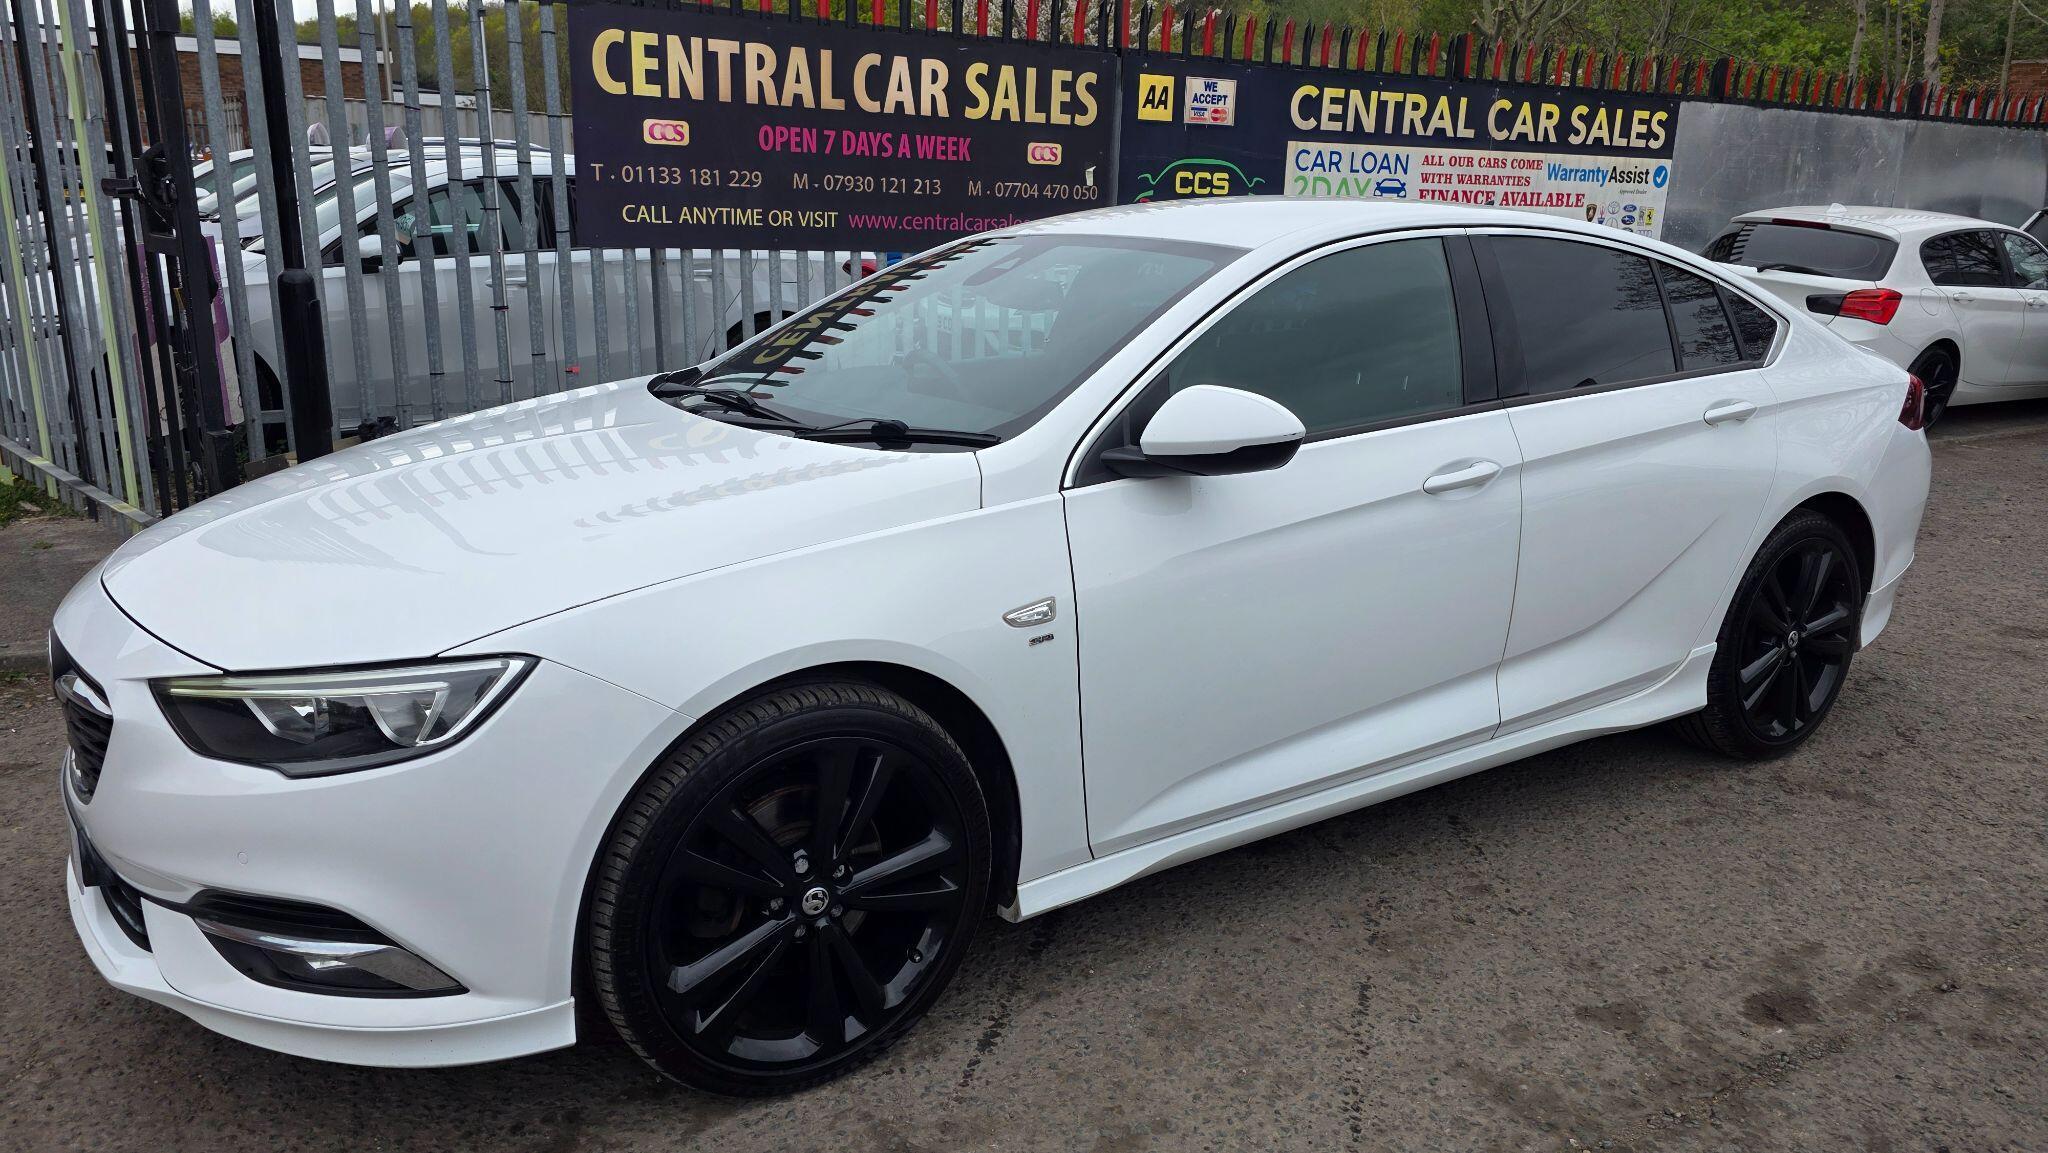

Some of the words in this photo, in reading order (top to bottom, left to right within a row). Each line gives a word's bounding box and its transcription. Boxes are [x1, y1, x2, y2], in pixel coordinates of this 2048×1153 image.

[592, 28, 846, 110] CENTRAL
[853, 53, 950, 117] CAR
[965, 62, 1098, 126] SALES
[1204, 81, 1218, 92] WE
[1142, 85, 1169, 110] AA
[1192, 93, 1228, 105] ACCEPT
[1290, 84, 1475, 138] CENTRAL
[1487, 99, 1560, 143] CAR
[1568, 105, 1669, 149] SALES
[648, 123, 686, 142] CCS
[758, 125, 816, 153] OPEN
[823, 129, 835, 154] 7
[842, 130, 893, 158] DAYS
[898, 133, 911, 158] A
[916, 135, 972, 161] WEEK
[1031, 146, 1059, 162] CCS
[1295, 149, 1342, 172] CAR
[1350, 151, 1409, 175] LOAN
[1422, 155, 1444, 167] ALL
[1449, 156, 1474, 168] OUR
[1477, 157, 1507, 169] CARS
[1510, 158, 1543, 171] COME
[621, 165, 682, 184] 01133
[689, 168, 720, 185] 181
[728, 170, 763, 188] 229
[824, 175, 874, 192] 07930
[880, 177, 906, 193] 121
[914, 179, 941, 195] 213
[995, 182, 1039, 198] 07704
[1043, 183, 1069, 199] 470
[1073, 184, 1098, 200] 050
[1175, 171, 1230, 195] CCS
[1421, 173, 1451, 184] WITH
[1456, 174, 1531, 187] WARRANTIES
[1419, 189, 1495, 205] FINANCE
[1499, 191, 1586, 208] AVAILABLE
[622, 205, 673, 224] CALL
[679, 206, 763, 226] ANYTIME
[768, 209, 793, 227] OR
[798, 210, 838, 228] VISIT
